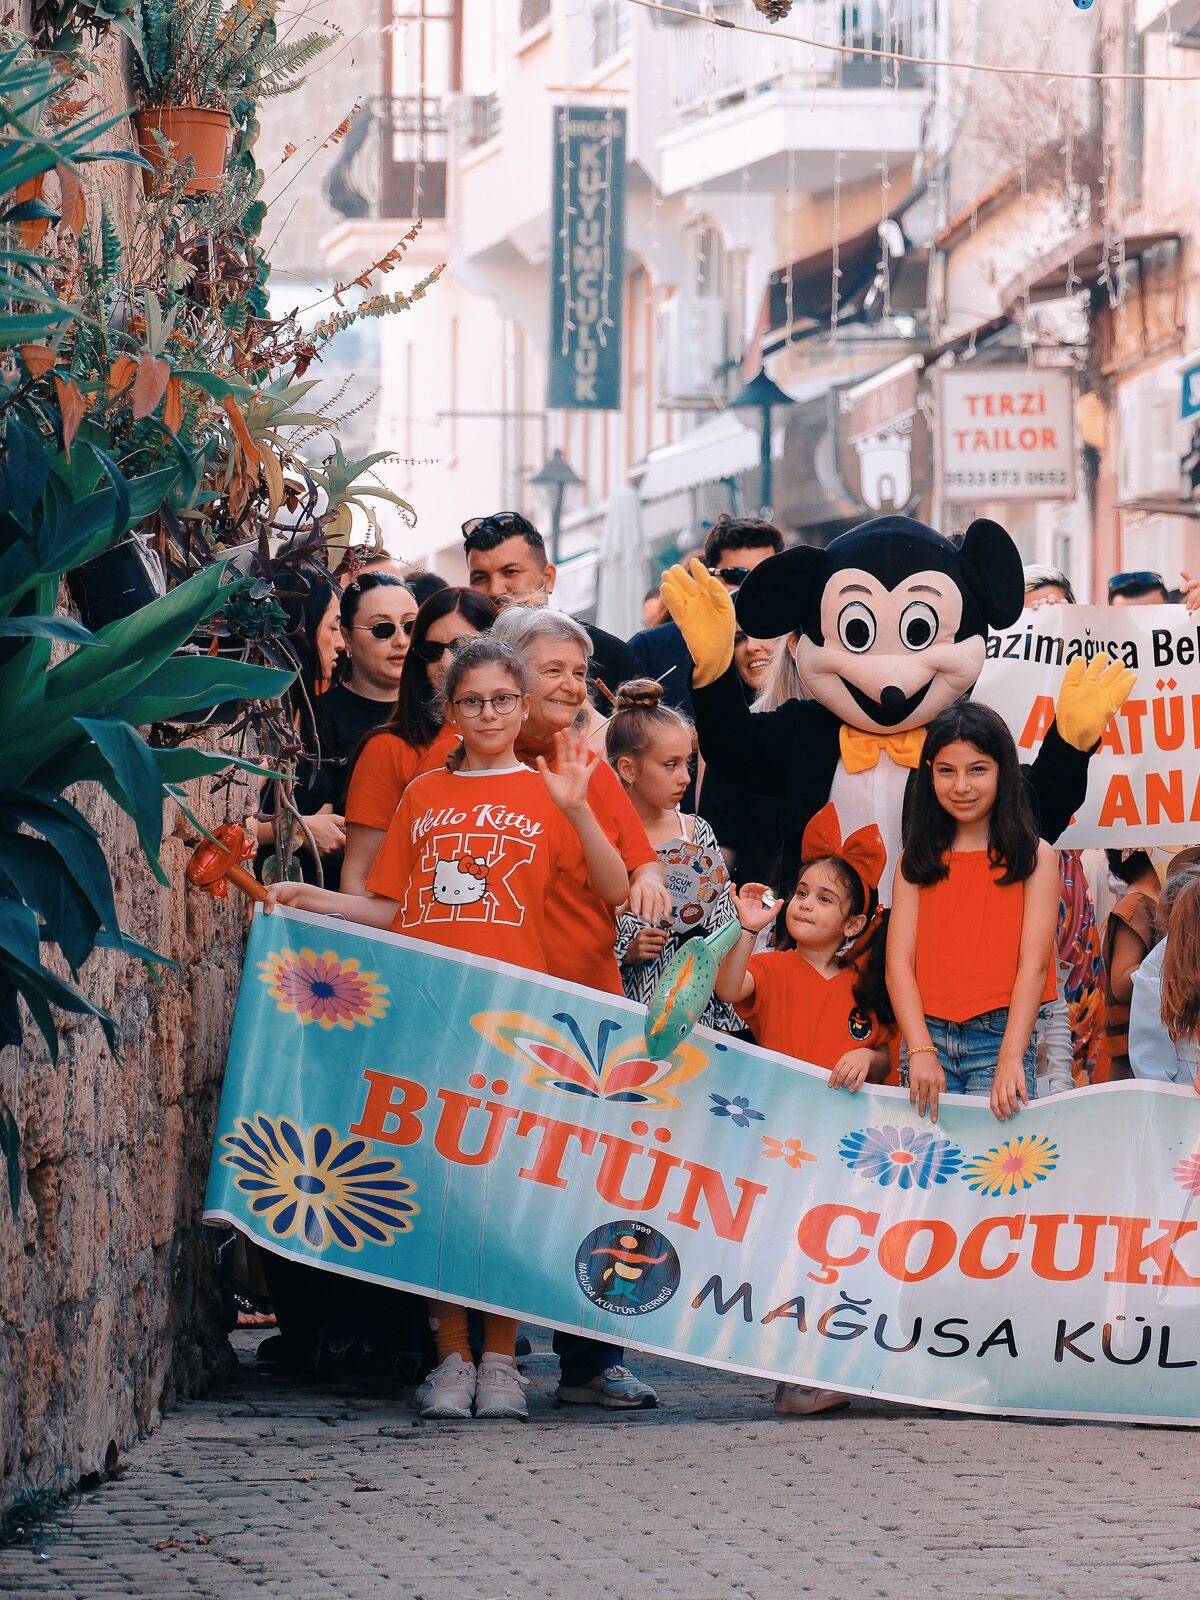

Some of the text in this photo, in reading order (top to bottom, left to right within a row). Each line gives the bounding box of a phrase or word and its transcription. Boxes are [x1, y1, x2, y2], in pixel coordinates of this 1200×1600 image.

[573, 142, 604, 401] KUYUMCULUK
[964, 385, 1046, 417] TERZİ
[953, 428, 1058, 452] TAILOR
[985, 624, 1139, 669] azimağsa
[411, 804, 545, 845] Hello Kitty
[349, 1068, 767, 1243] BÜTÜN
[630, 1223, 652, 1235] 1999
[578, 1261, 597, 1298] MAĞUSA
[691, 1275, 1019, 1359] MAĞUSA
